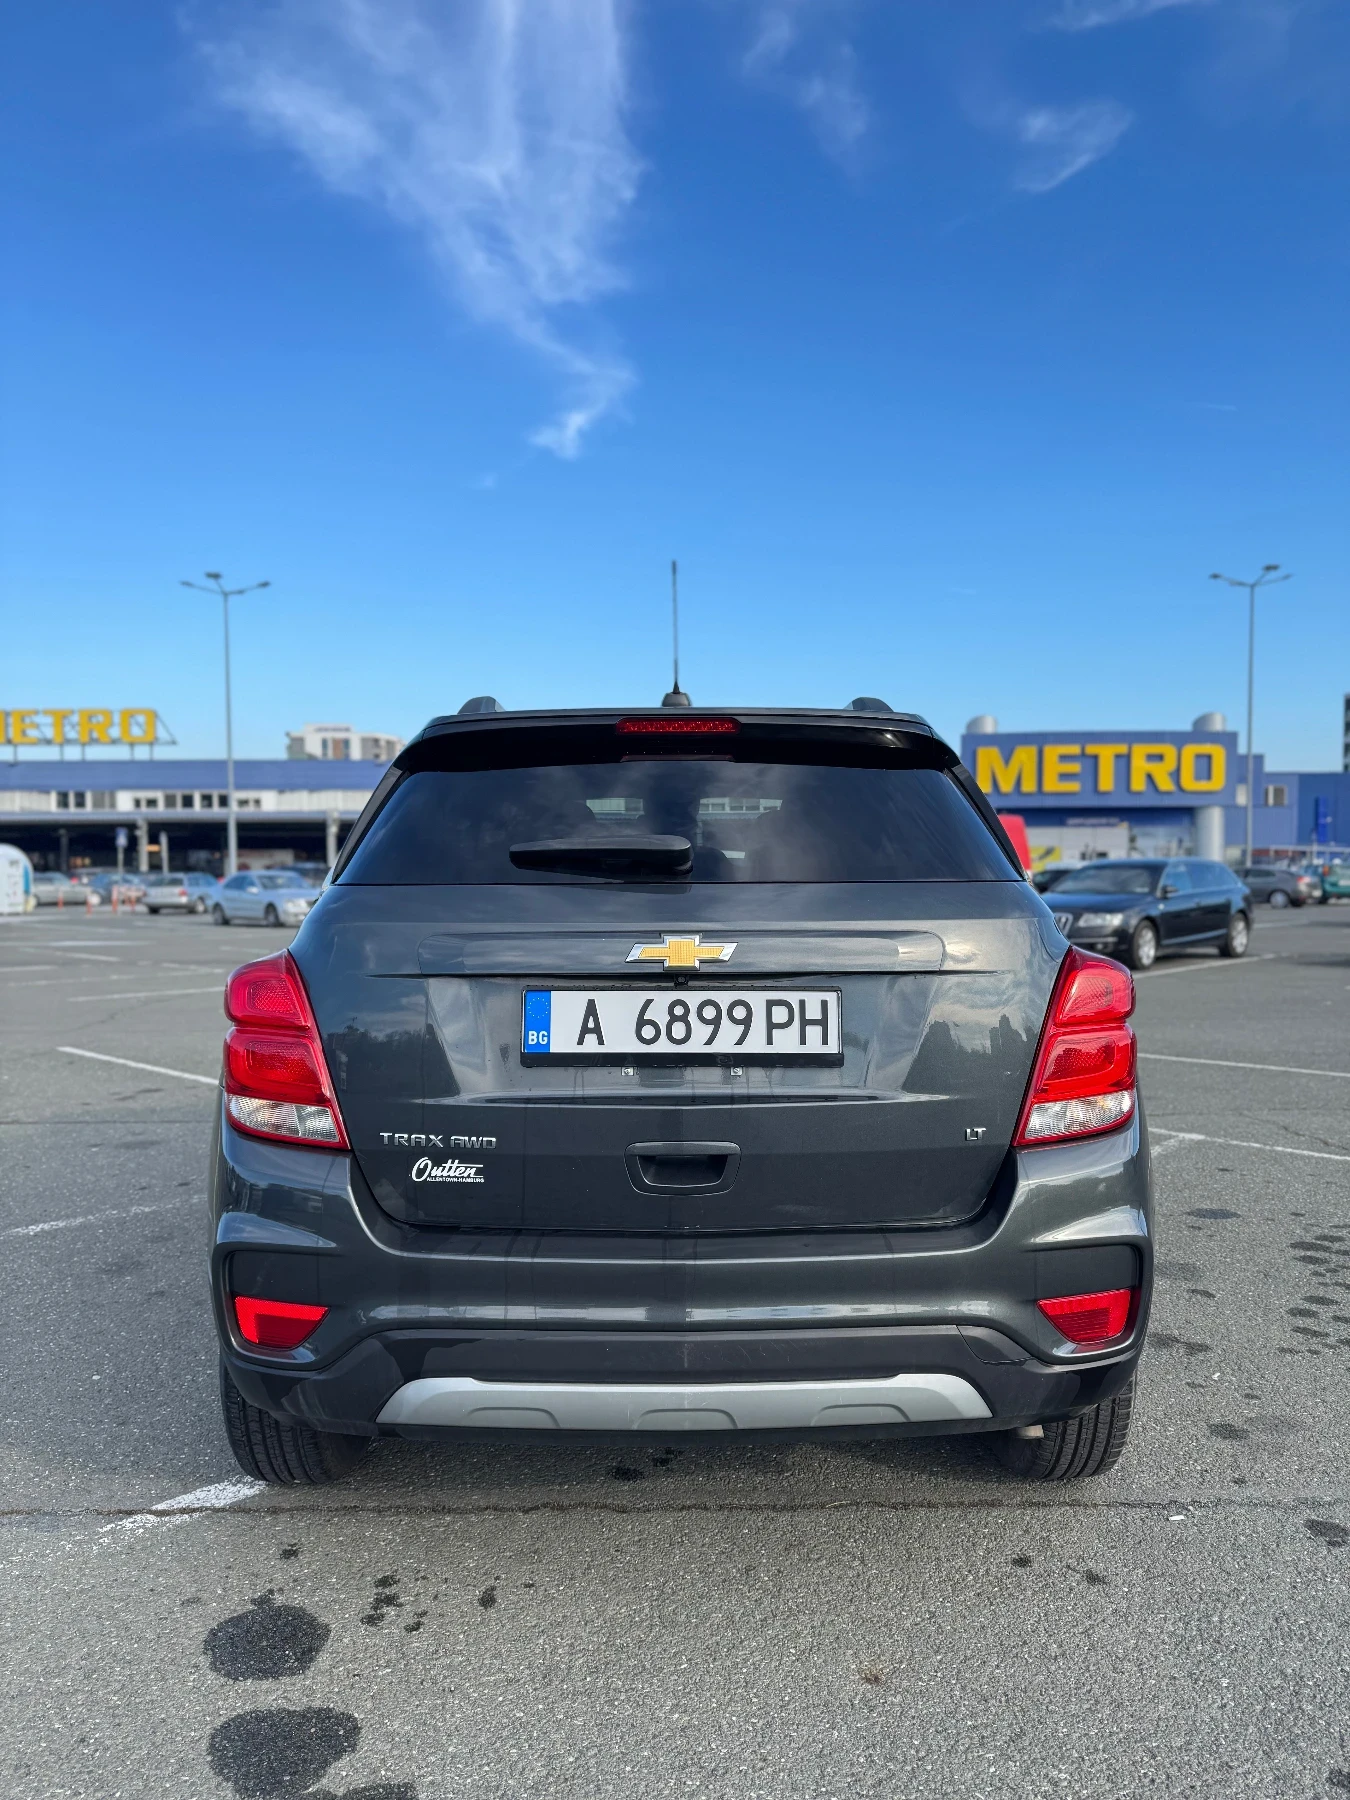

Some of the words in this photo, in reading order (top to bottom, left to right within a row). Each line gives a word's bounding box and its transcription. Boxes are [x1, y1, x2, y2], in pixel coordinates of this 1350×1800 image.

[0, 708, 156, 744] ETRO
[975, 743, 1226, 794] METRO
[577, 999, 605, 1045] A
[635, 999, 753, 1045] 6899
[765, 999, 829, 1046] PH
[528, 1031, 548, 1045] BG
[380, 1132, 443, 1148] TRAX
[450, 1135, 497, 1149] AWD
[965, 1127, 987, 1141] LT
[412, 1157, 483, 1181] Outten
